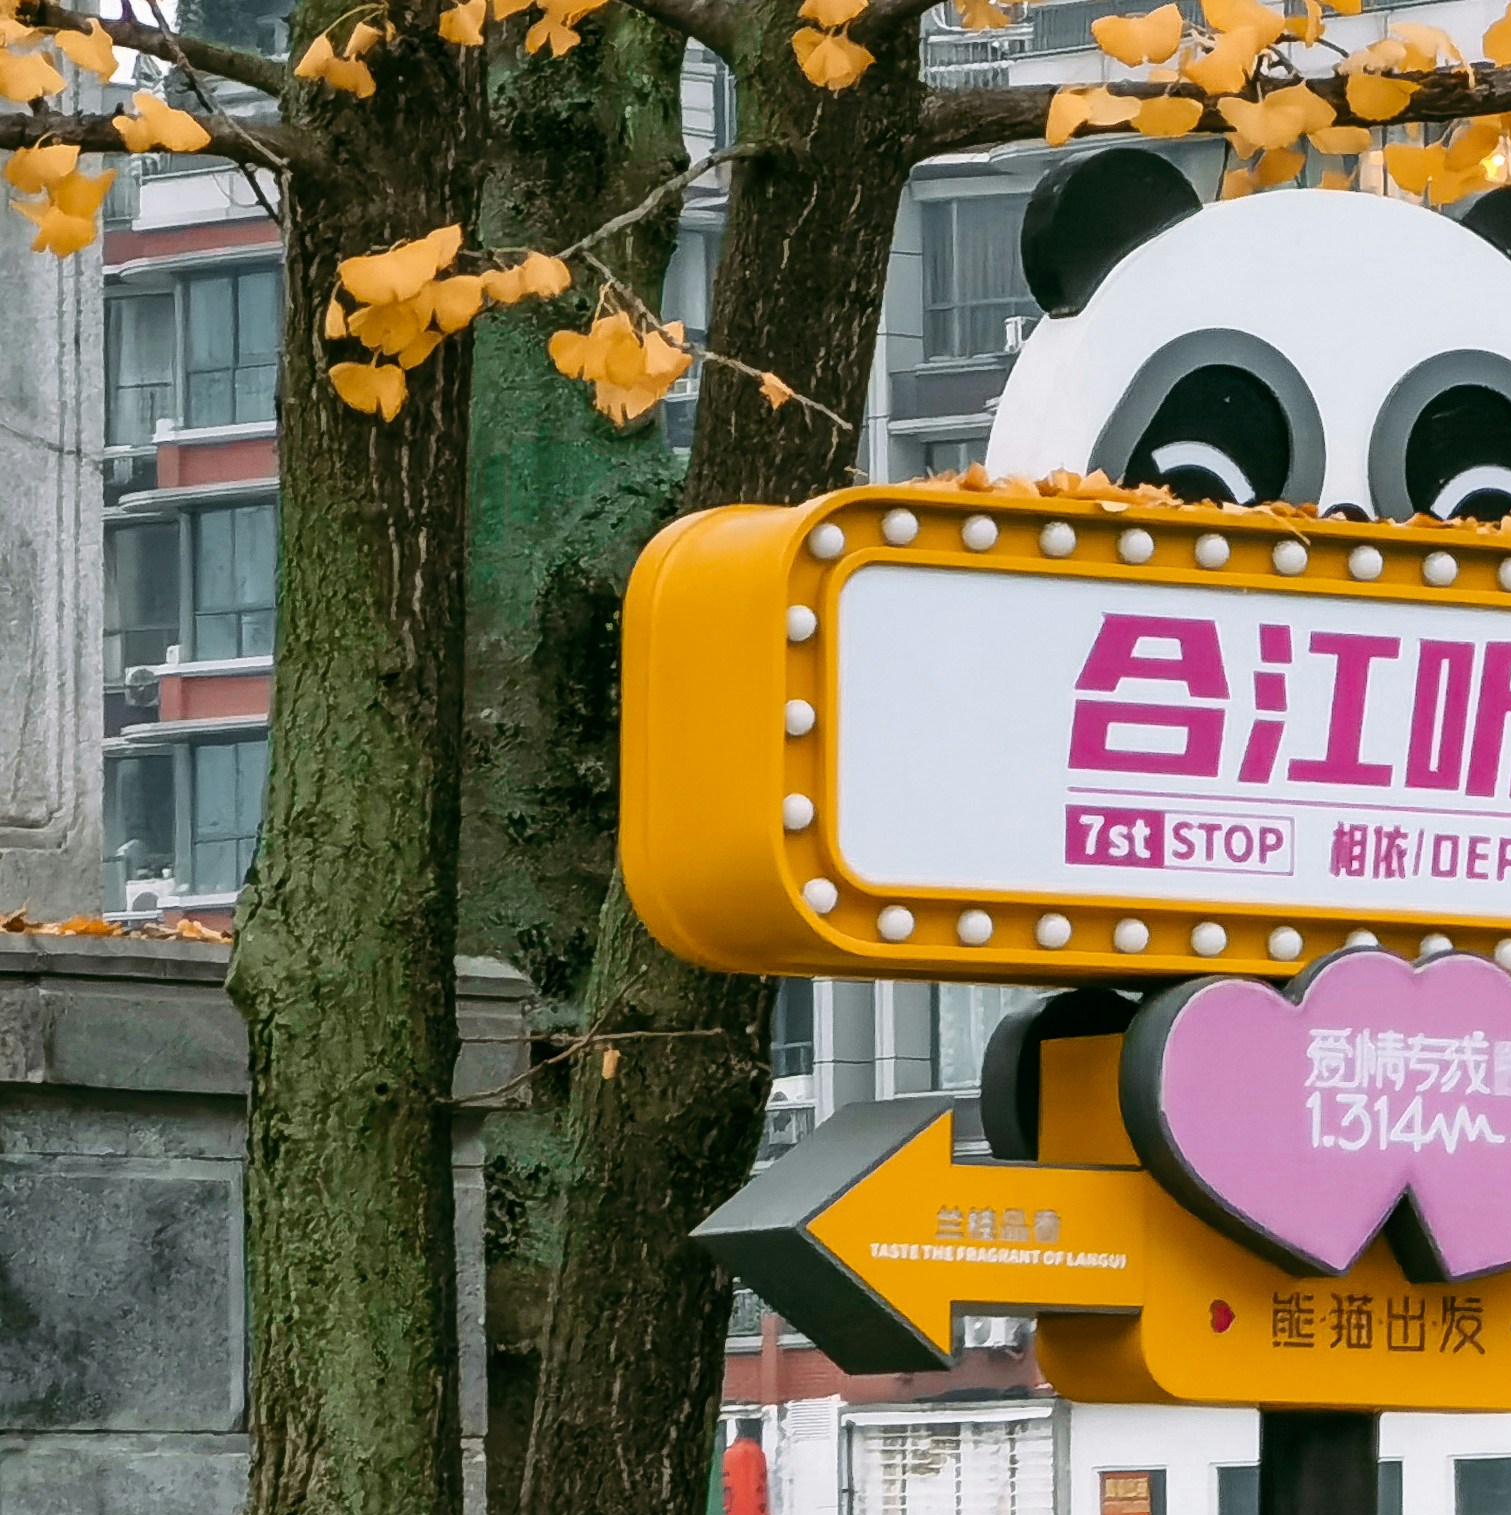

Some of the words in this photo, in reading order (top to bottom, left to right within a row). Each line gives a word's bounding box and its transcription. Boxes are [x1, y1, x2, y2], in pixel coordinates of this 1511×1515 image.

[1078, 813, 1151, 859] 7st
[1171, 821, 1285, 865] STOP
[869, 1242, 919, 1261] TASTE
[922, 1244, 952, 1263] THE
[956, 1246, 1041, 1266] FRAGRANT
[1043, 1250, 1063, 1266] OF
